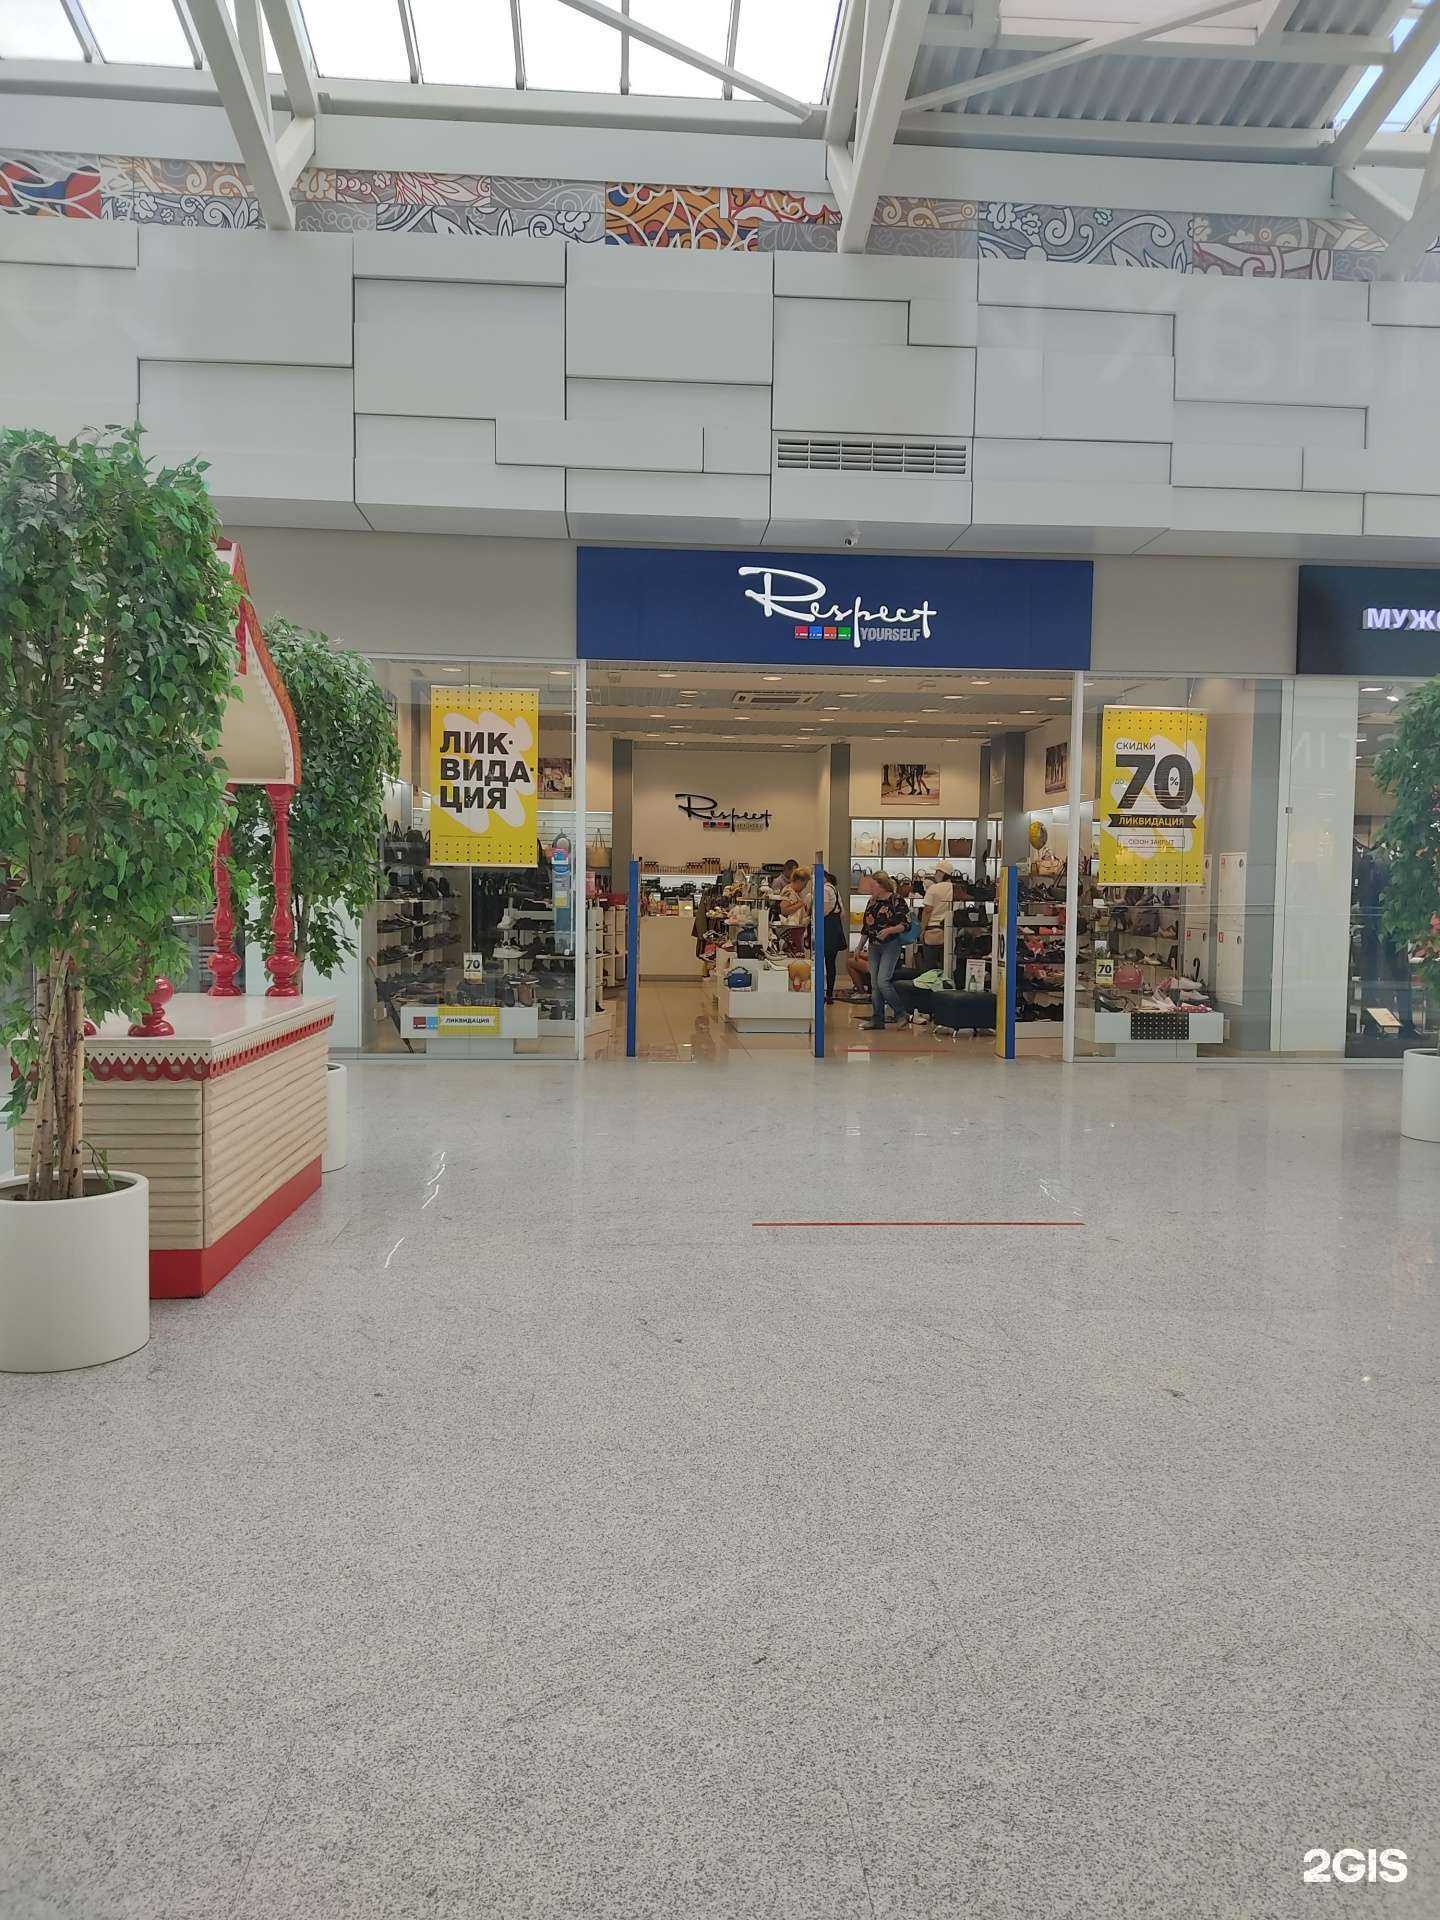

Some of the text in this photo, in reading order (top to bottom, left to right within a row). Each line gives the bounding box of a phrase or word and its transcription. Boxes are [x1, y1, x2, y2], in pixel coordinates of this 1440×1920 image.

[738, 566, 937, 648] Respect
[1362, 607, 1440, 631] МУЖ
[861, 627, 921, 641] YOURSELF
[1116, 742, 1156, 750] СКИДКИ
[440, 786, 507, 813] ЦИЯ
[675, 793, 772, 832] Respect
[1119, 816, 1184, 826] ЛИКВИДАЦИЯ
[466, 960, 480, 969] 70
[1099, 965, 1111, 973] 70
